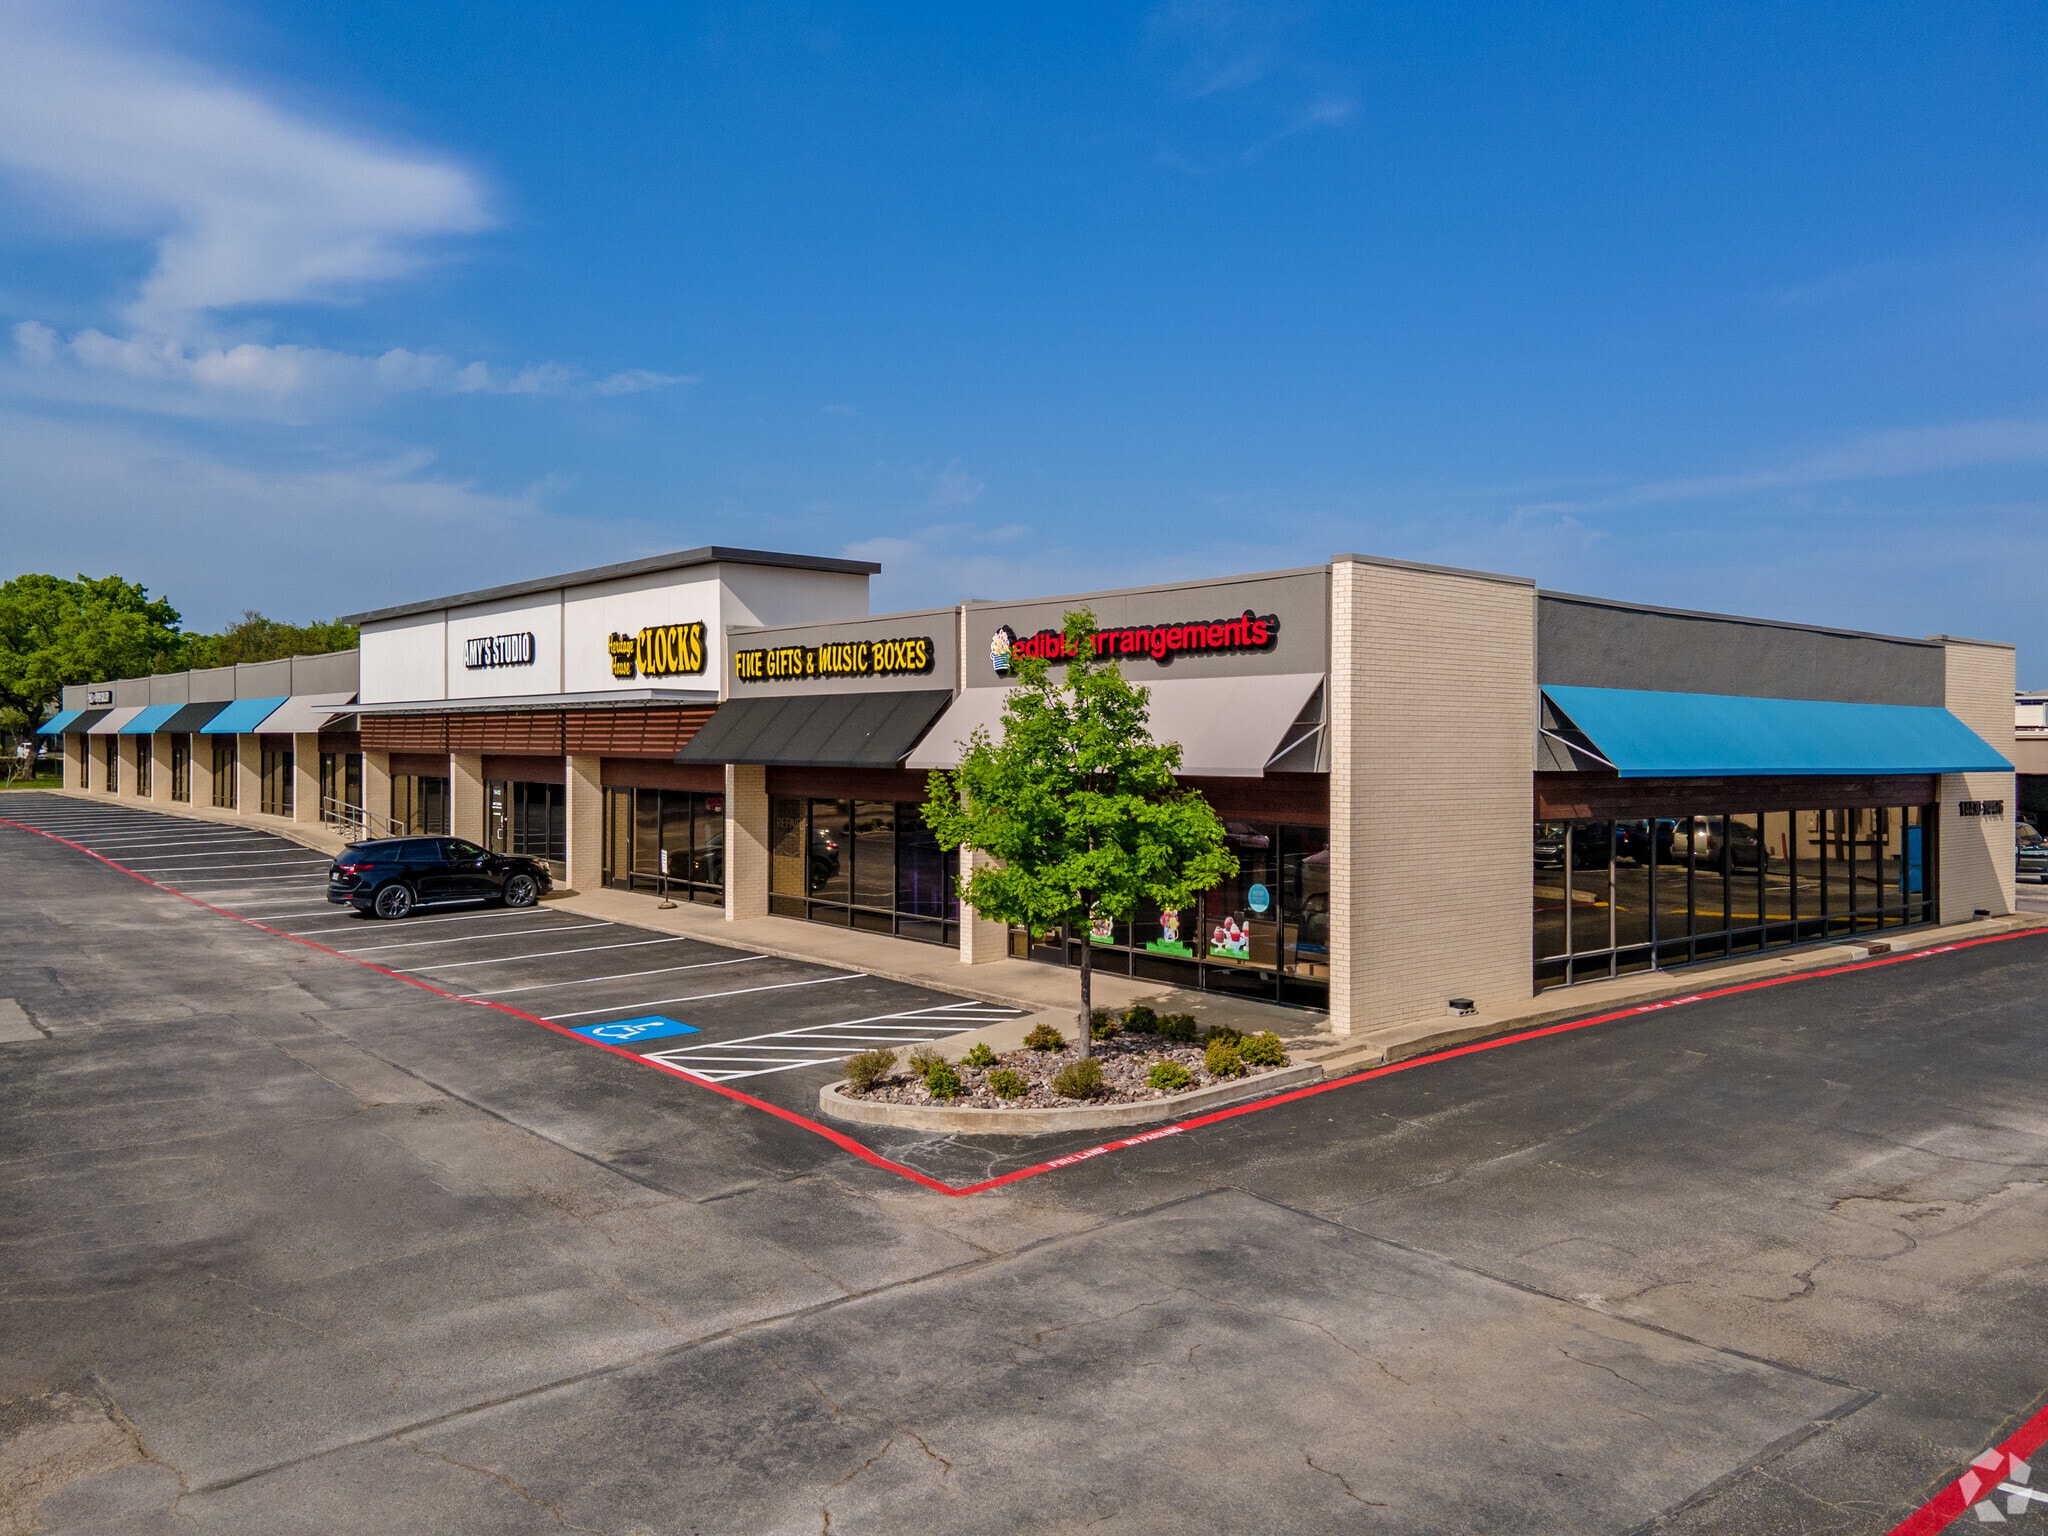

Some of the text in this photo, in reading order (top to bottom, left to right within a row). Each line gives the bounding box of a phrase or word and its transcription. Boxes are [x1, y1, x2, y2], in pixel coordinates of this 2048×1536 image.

[463, 633, 530, 667] AMY'S STUDIO
[608, 634, 634, 658] Heritage
[636, 624, 701, 674] CLOCKS
[735, 652, 762, 677] FINE
[766, 649, 802, 676] GIFTS
[818, 643, 868, 673] MUSIC
[872, 640, 927, 671] BOXES
[612, 655, 631, 676] House
